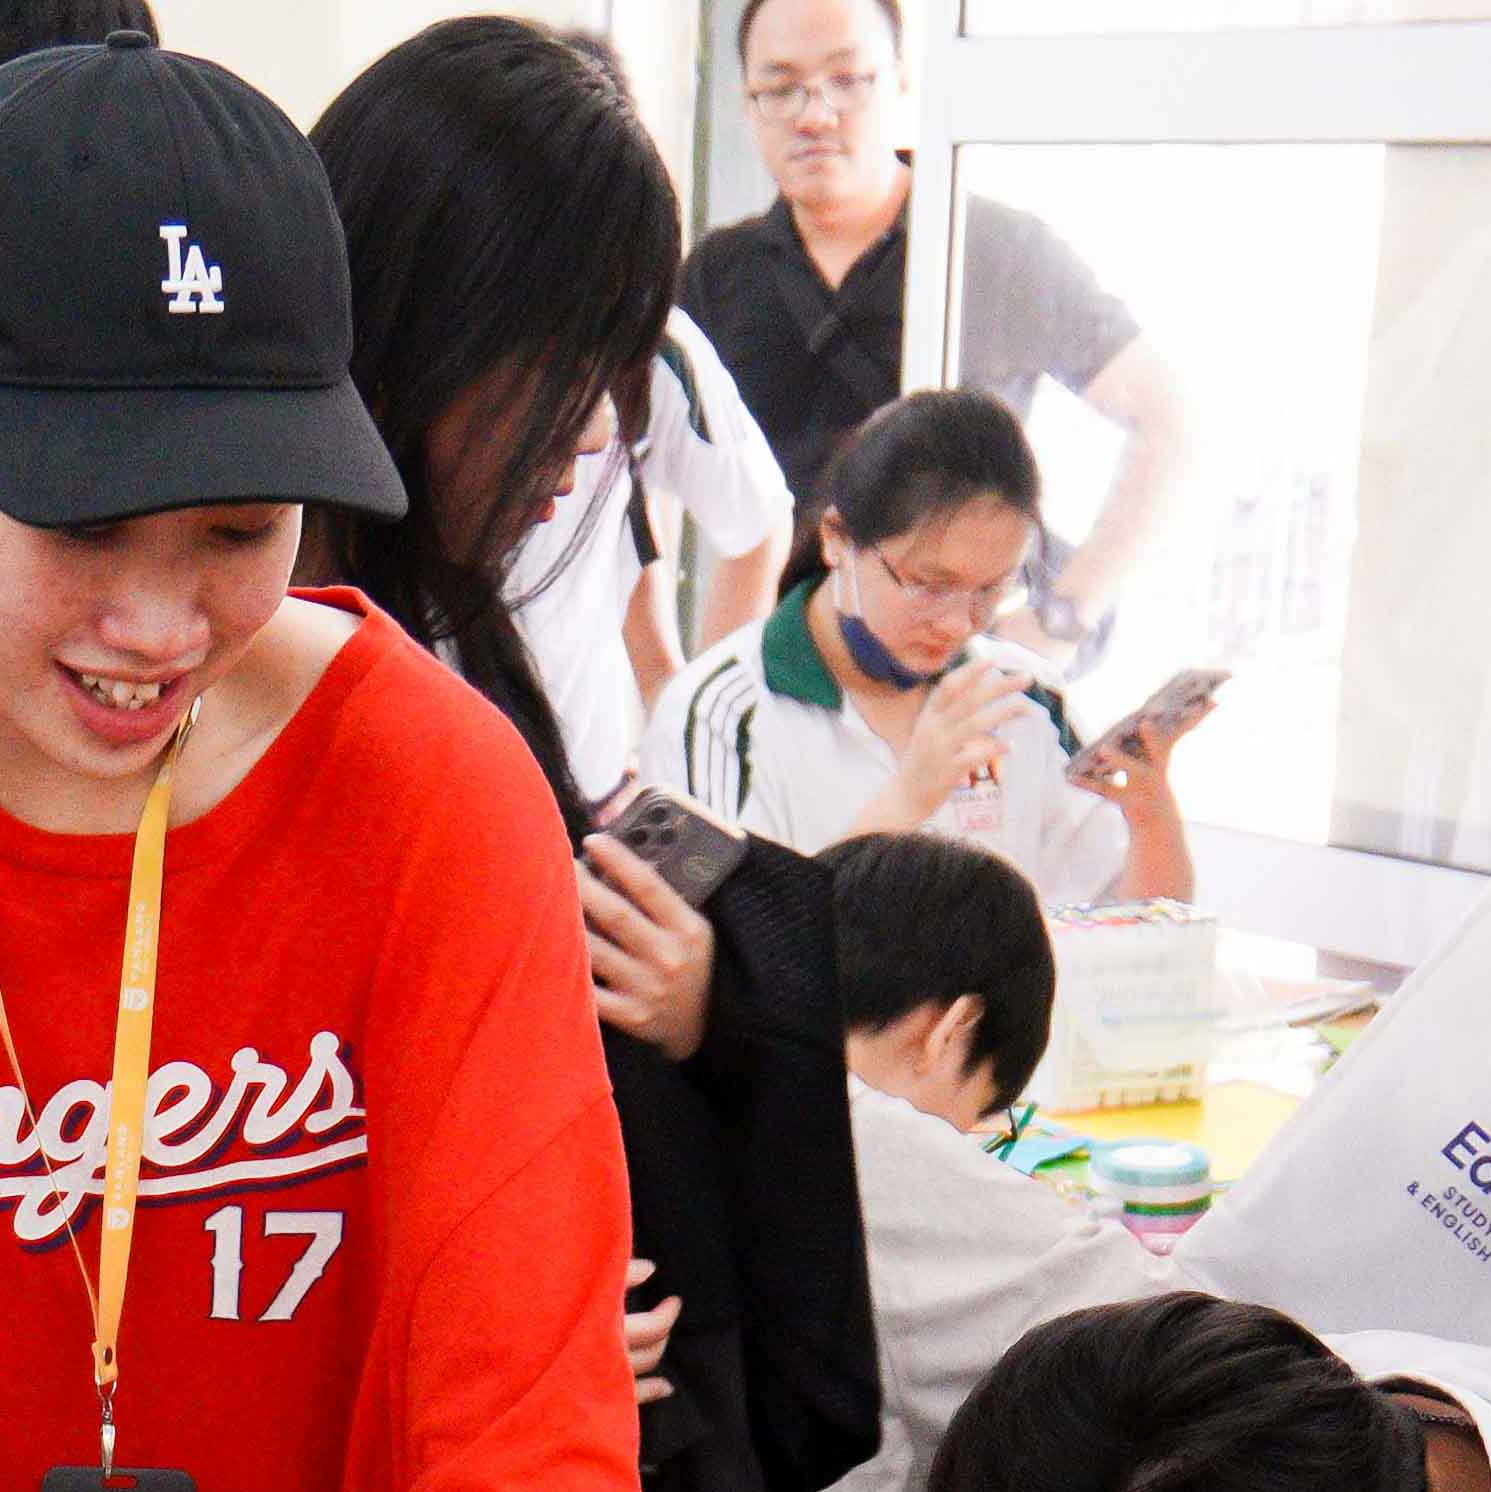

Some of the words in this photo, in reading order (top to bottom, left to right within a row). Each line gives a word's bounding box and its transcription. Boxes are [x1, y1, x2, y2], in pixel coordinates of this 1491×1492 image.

[160, 225, 224, 313] LA
[1406, 1181, 1420, 1197] &
[203, 1205, 344, 1321] 17
